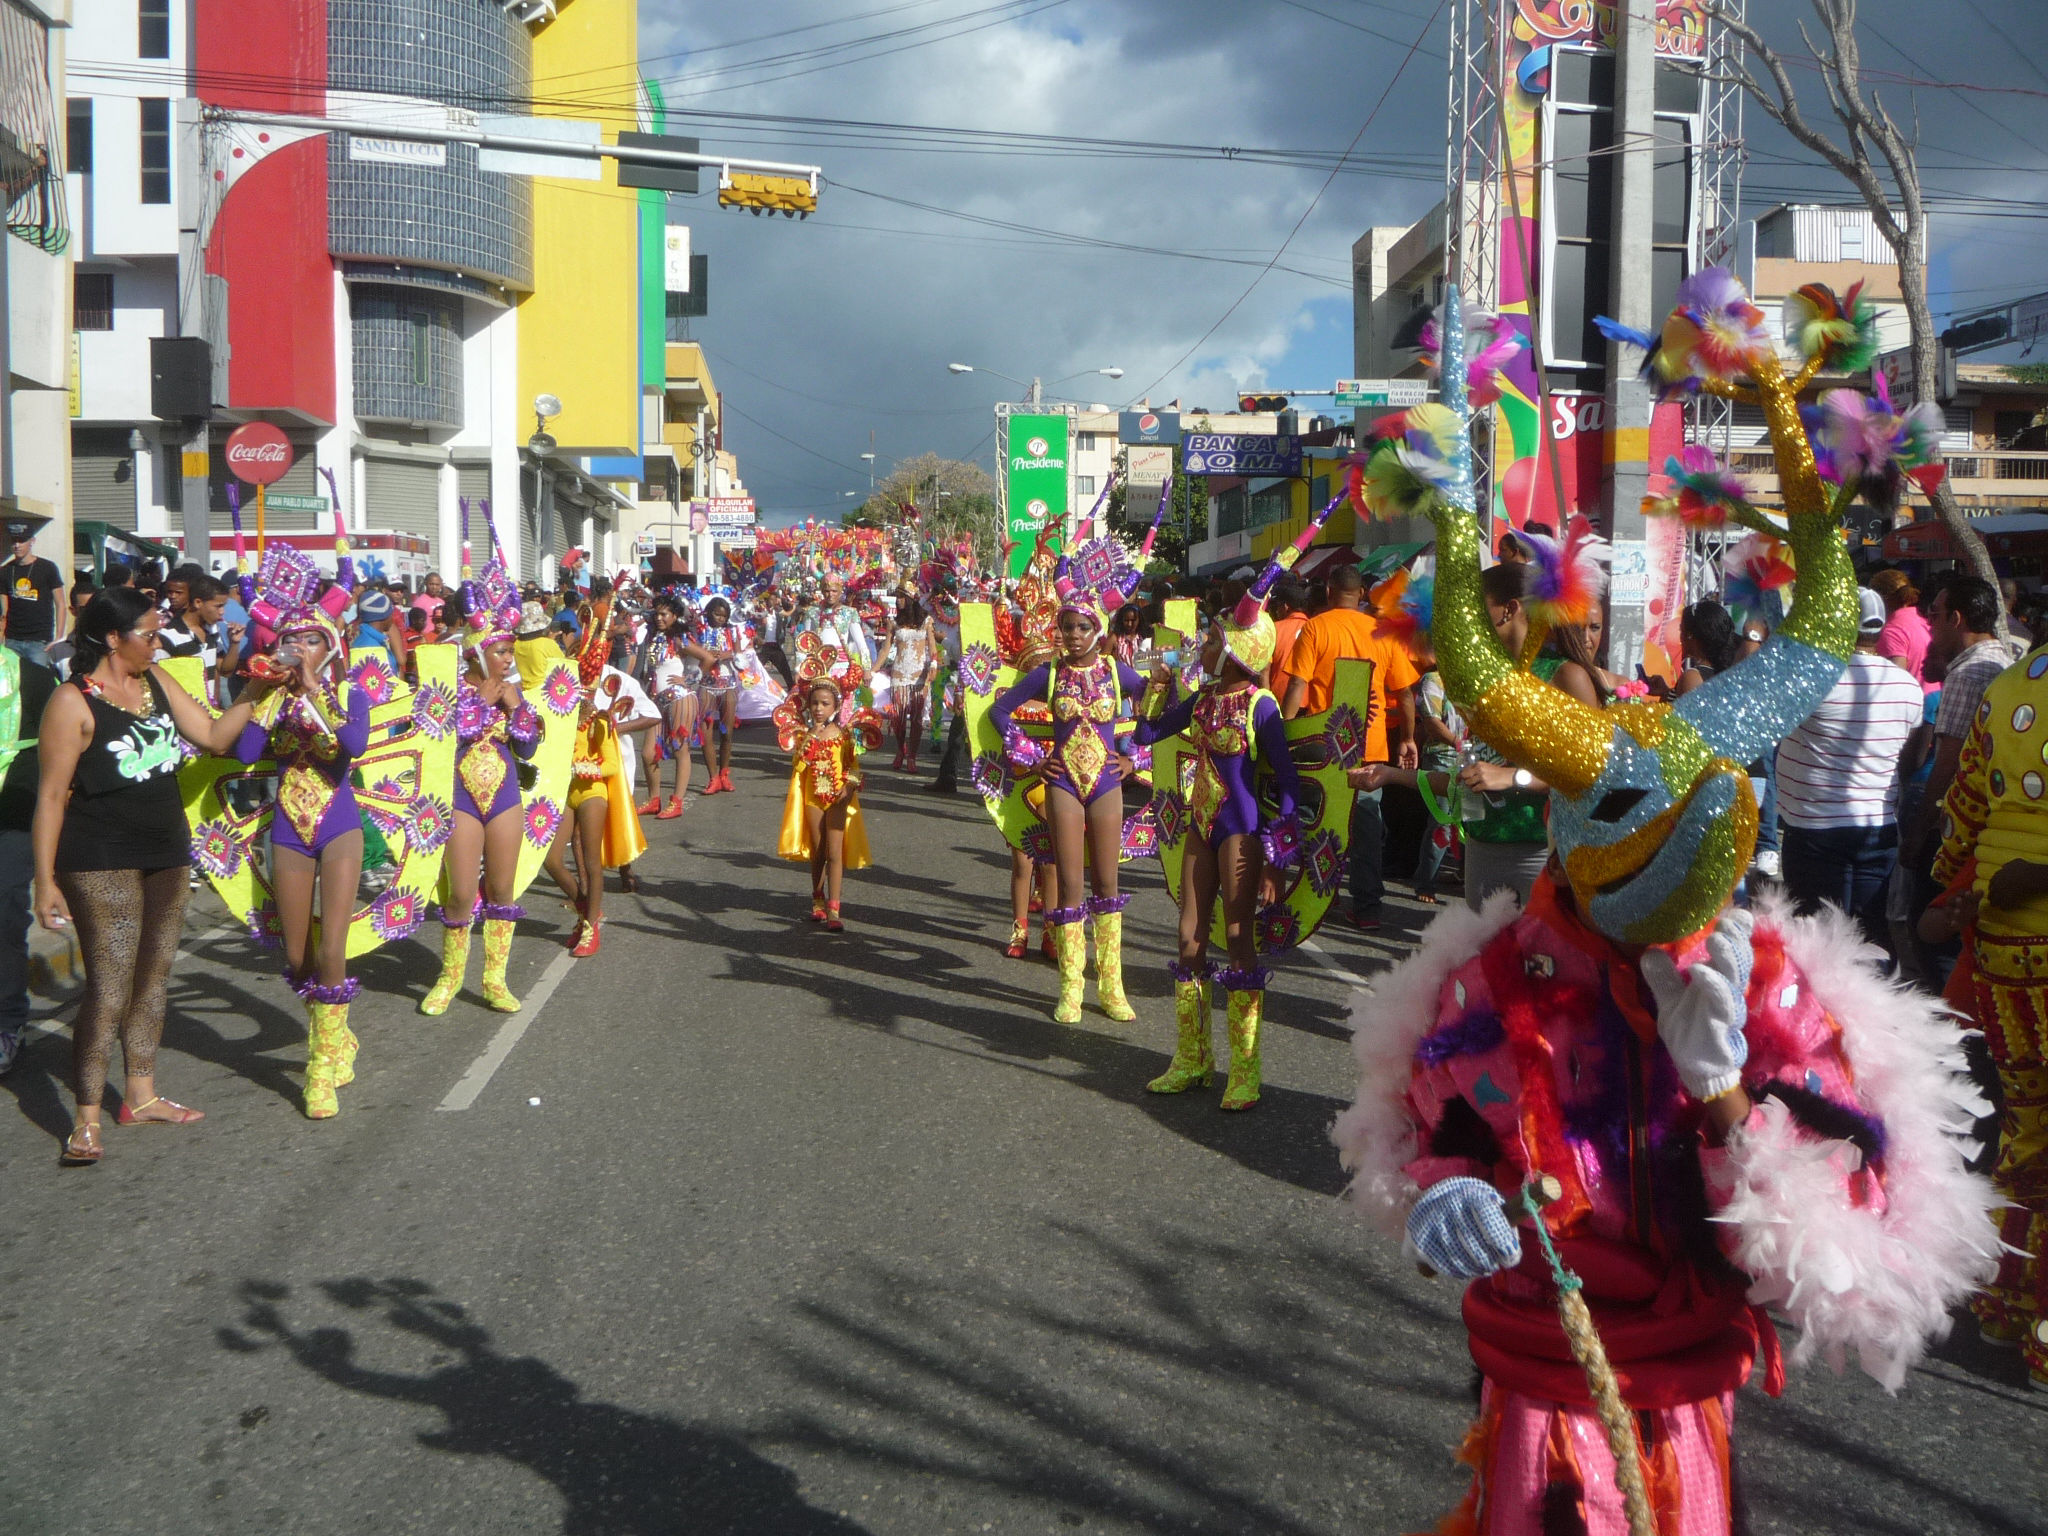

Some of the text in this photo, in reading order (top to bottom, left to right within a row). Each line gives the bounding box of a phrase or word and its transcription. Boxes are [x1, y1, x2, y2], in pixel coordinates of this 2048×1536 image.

[355, 139, 441, 157] SANTA LUCIA
[1188, 435, 1273, 452] BANCA
[229, 443, 288, 462] Coca-Cola
[1011, 457, 1064, 471] Presidente
[1207, 453, 1282, 469] O.M.
[266, 495, 325, 509] JUAN PABLO DUARTE
[709, 514, 754, 522] 09-583-4880
[1011, 518, 1047, 533] Presid
[711, 530, 738, 538] SEPH
